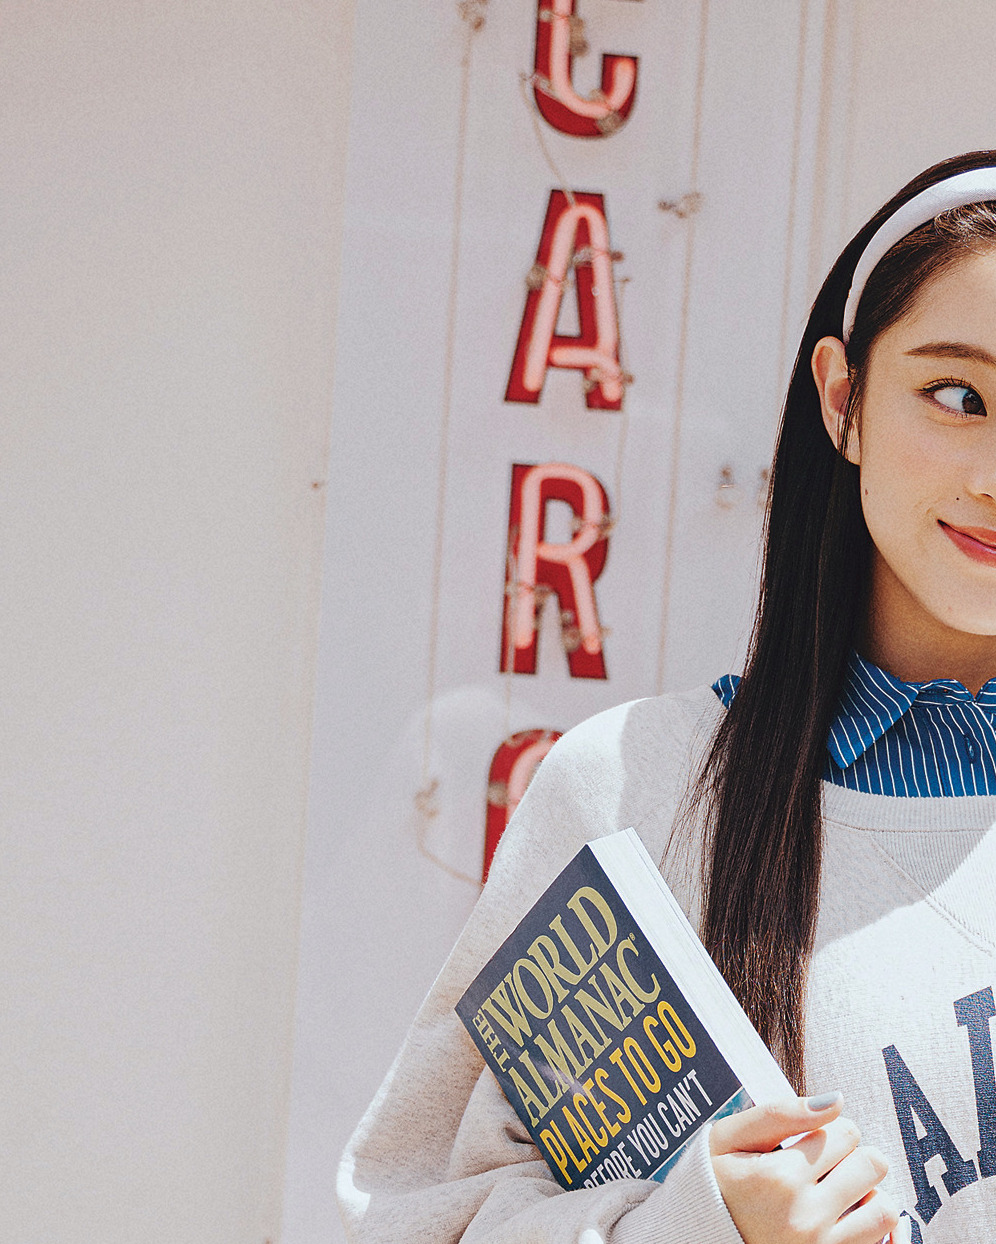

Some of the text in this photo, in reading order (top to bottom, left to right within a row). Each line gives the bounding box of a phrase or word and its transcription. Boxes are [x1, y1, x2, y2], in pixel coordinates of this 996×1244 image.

[473, 1000, 509, 1073] THE
[484, 886, 619, 1051] WORLD
[540, 1001, 697, 1185] PLACES TO GO
[584, 1069, 713, 1190] FORE YOU CAN'T
